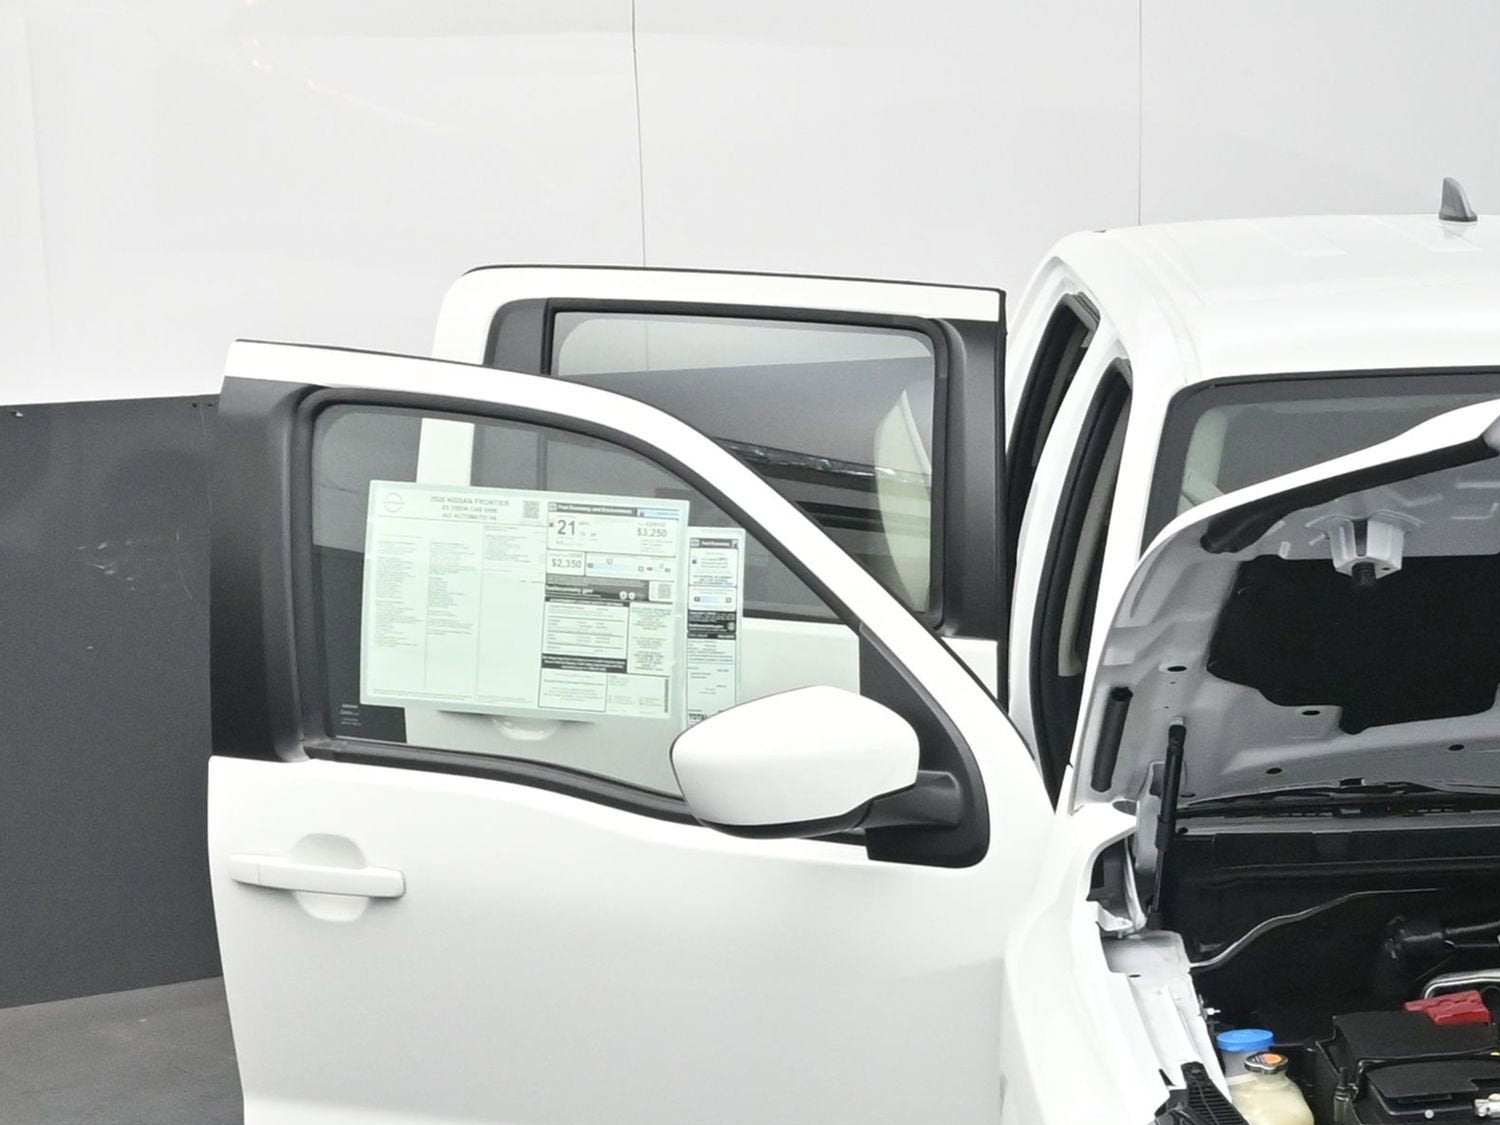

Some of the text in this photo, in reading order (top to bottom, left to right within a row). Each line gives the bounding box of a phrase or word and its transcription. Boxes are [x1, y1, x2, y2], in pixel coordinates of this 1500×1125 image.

[557, 519, 575, 536] 21
[636, 527, 668, 538] $3,250
[551, 558, 582, 569] $2,350
